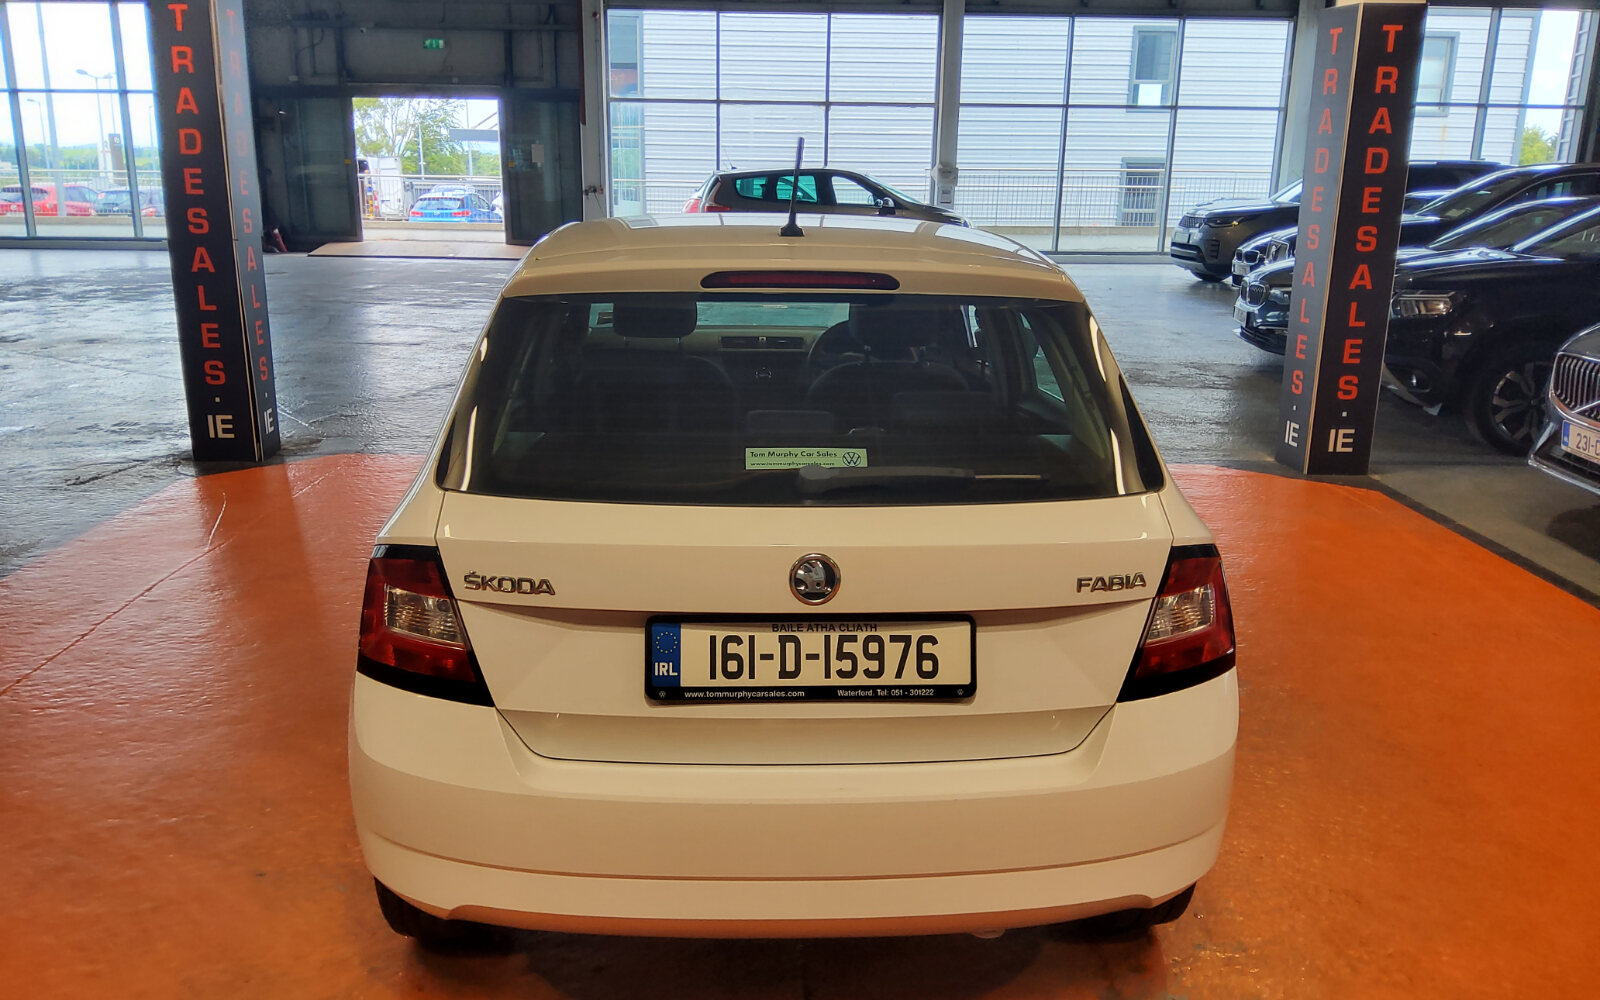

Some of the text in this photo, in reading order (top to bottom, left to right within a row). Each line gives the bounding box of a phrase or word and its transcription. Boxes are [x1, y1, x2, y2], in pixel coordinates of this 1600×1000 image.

[767, 451, 799, 459] Murphy
[463, 570, 556, 595] ŠKODA
[1076, 572, 1147, 593] FABIA
[772, 623, 878, 633] BAILE ATHA CLIATH
[709, 634, 939, 680] 161-D-15976
[654, 662, 679, 676] IRL
[684, 690, 805, 699] www.tommurphycarsales.com
[909, 688, 935, 696] 301222
